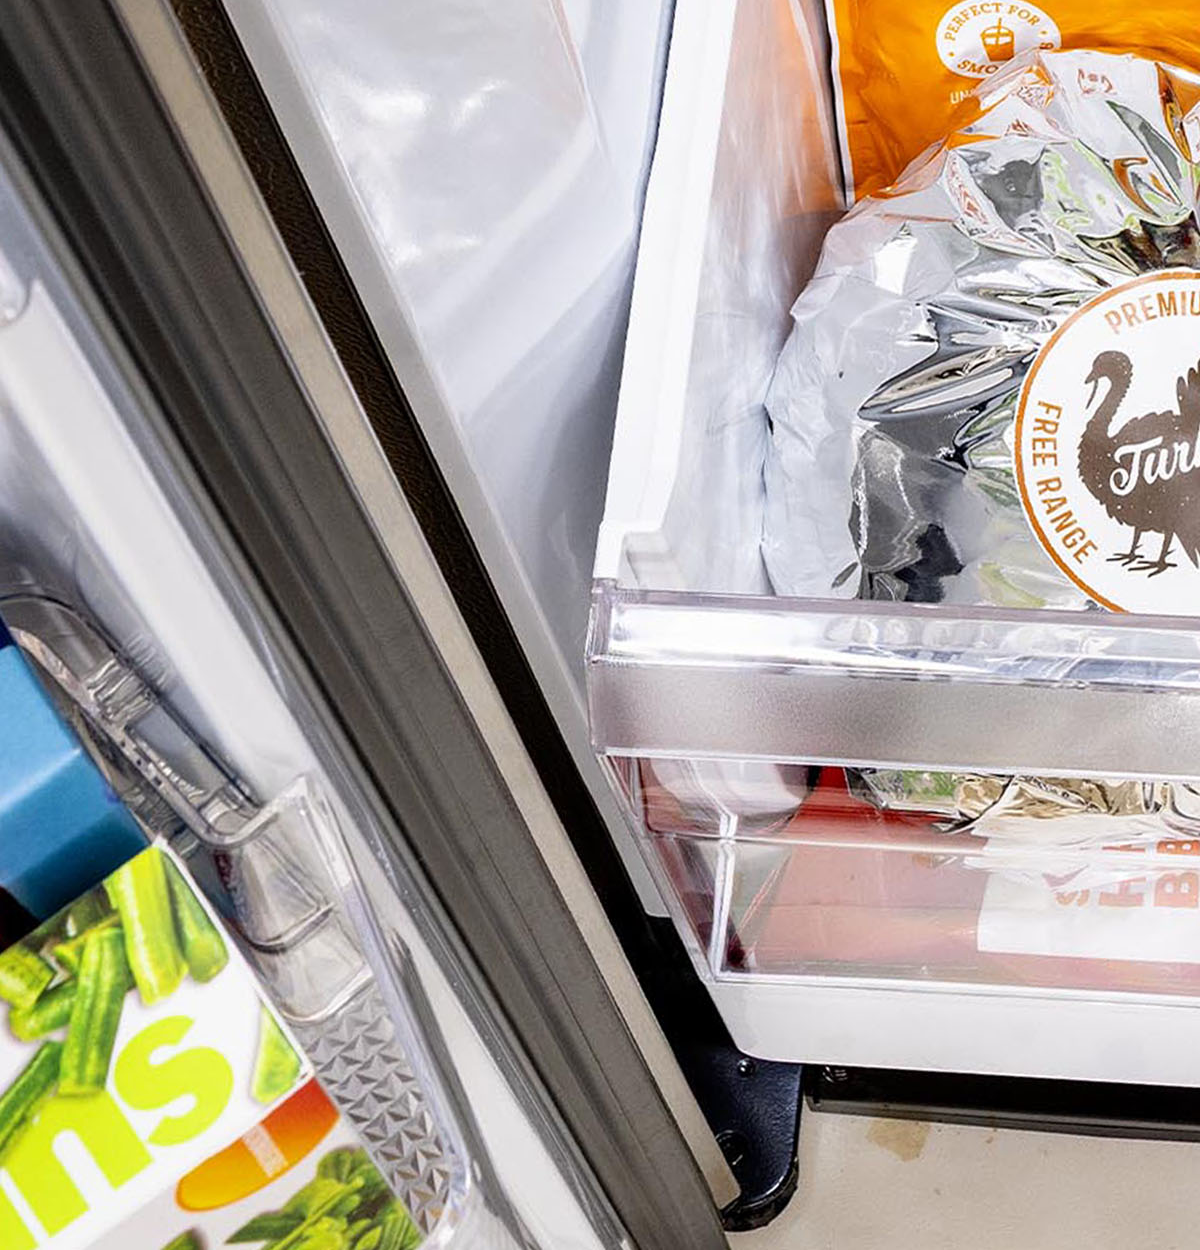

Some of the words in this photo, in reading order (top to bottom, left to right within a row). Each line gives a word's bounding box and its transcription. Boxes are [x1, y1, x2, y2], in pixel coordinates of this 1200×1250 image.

[944, 2, 1003, 42] PERFECT
[1007, 4, 1041, 26] FOR
[1031, 400, 1063, 467] FREE
[1036, 476, 1098, 565] RANGE
